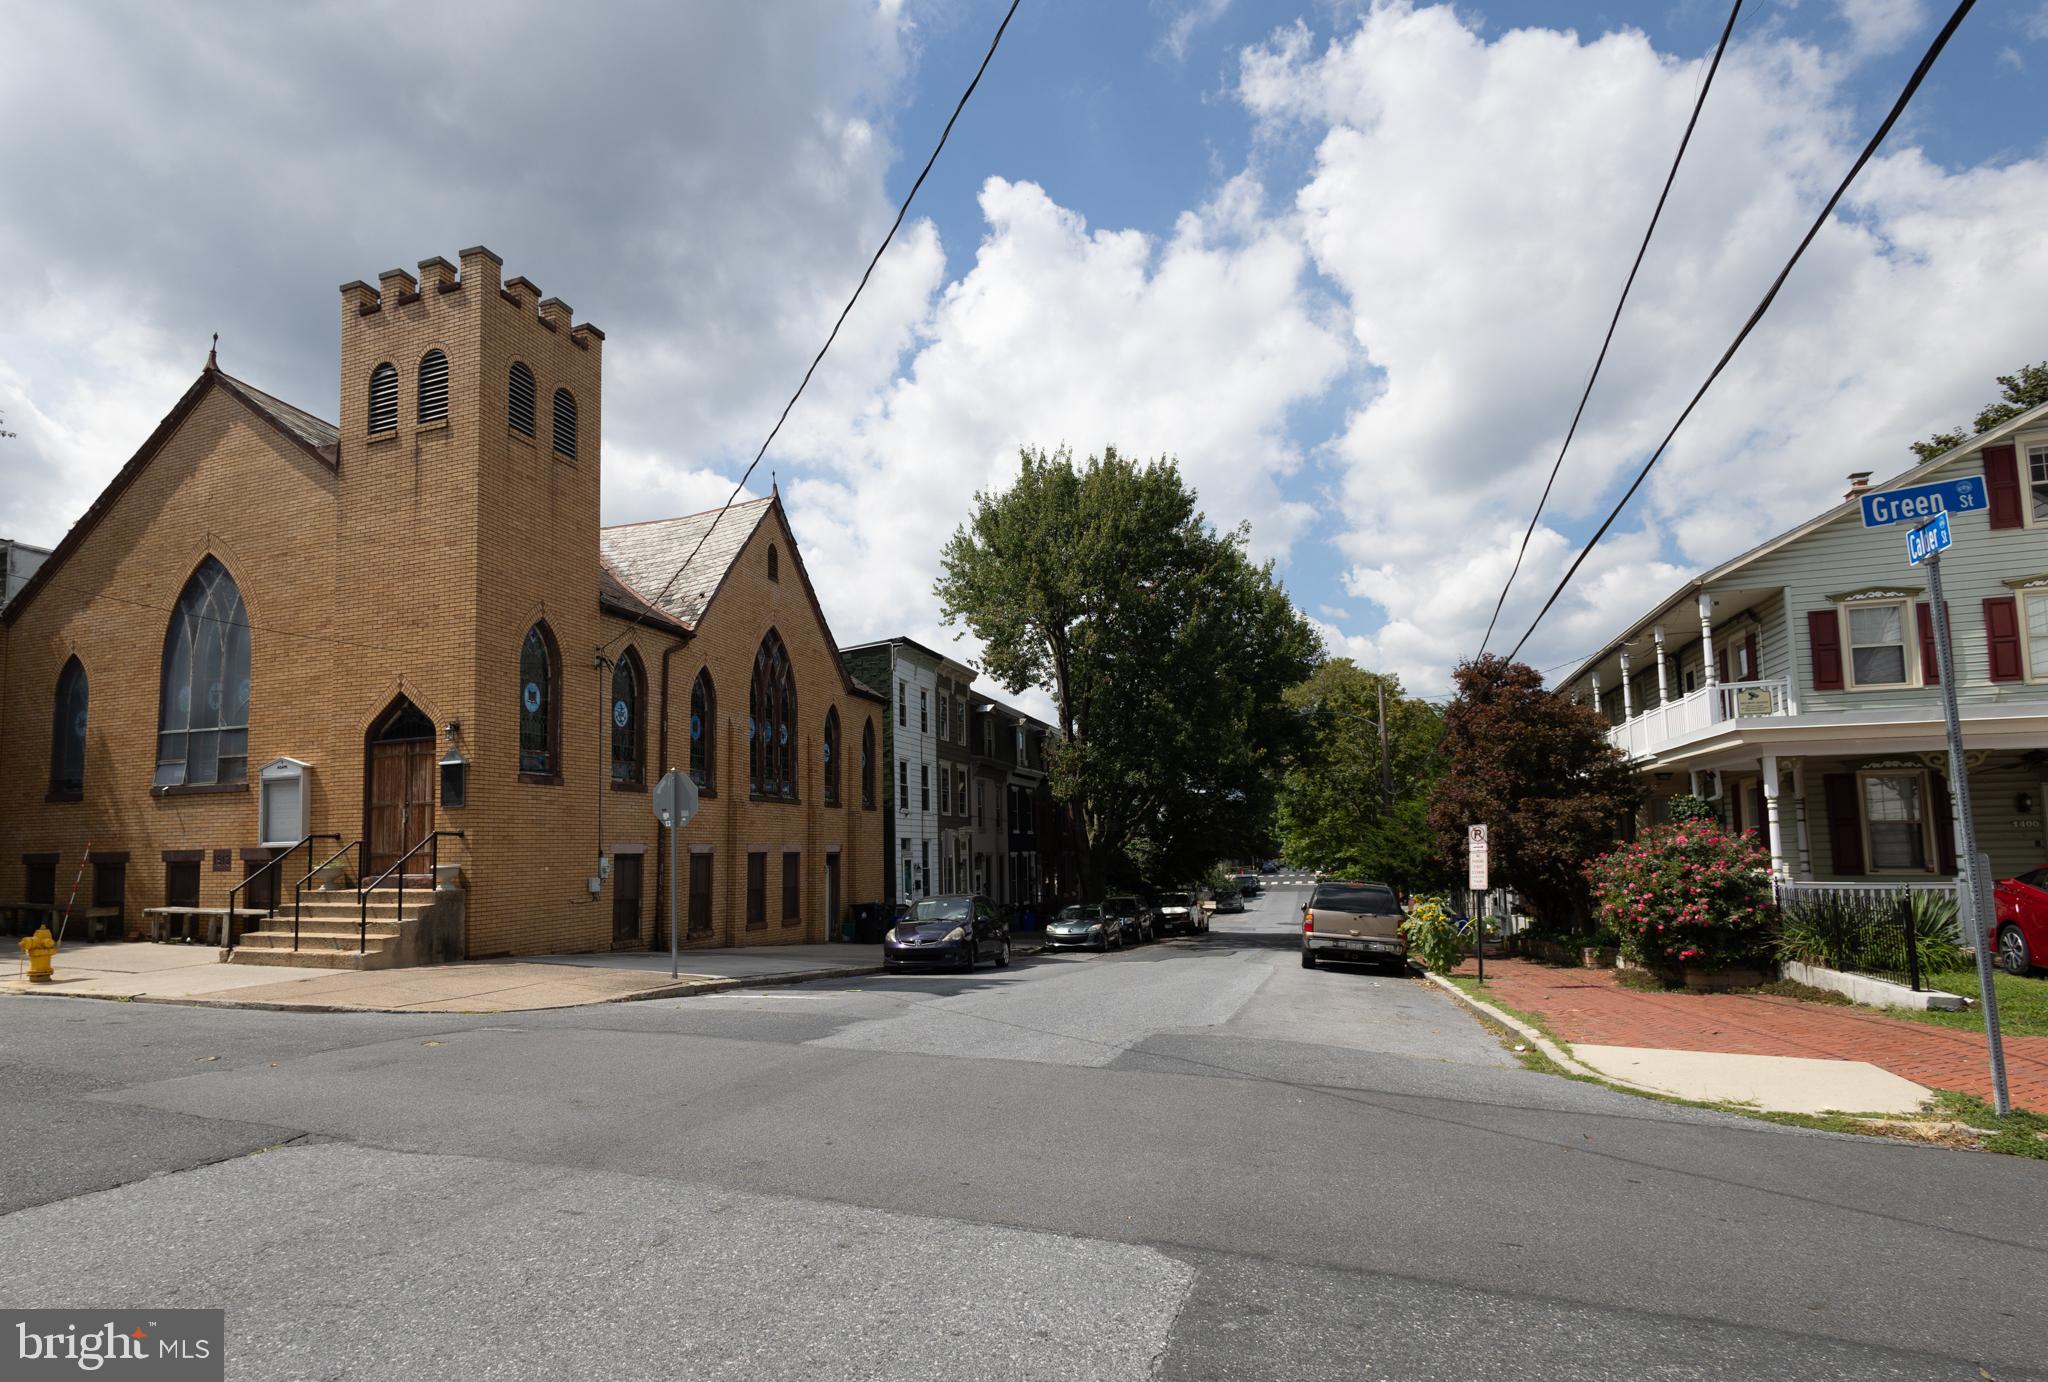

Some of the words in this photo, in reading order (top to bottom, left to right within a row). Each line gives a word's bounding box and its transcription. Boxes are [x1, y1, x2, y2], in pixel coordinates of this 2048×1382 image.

[1872, 493, 1944, 522] Green
[1959, 494, 1974, 508] St
[1910, 527, 1938, 560] Calder
[1941, 530, 1947, 544] St
